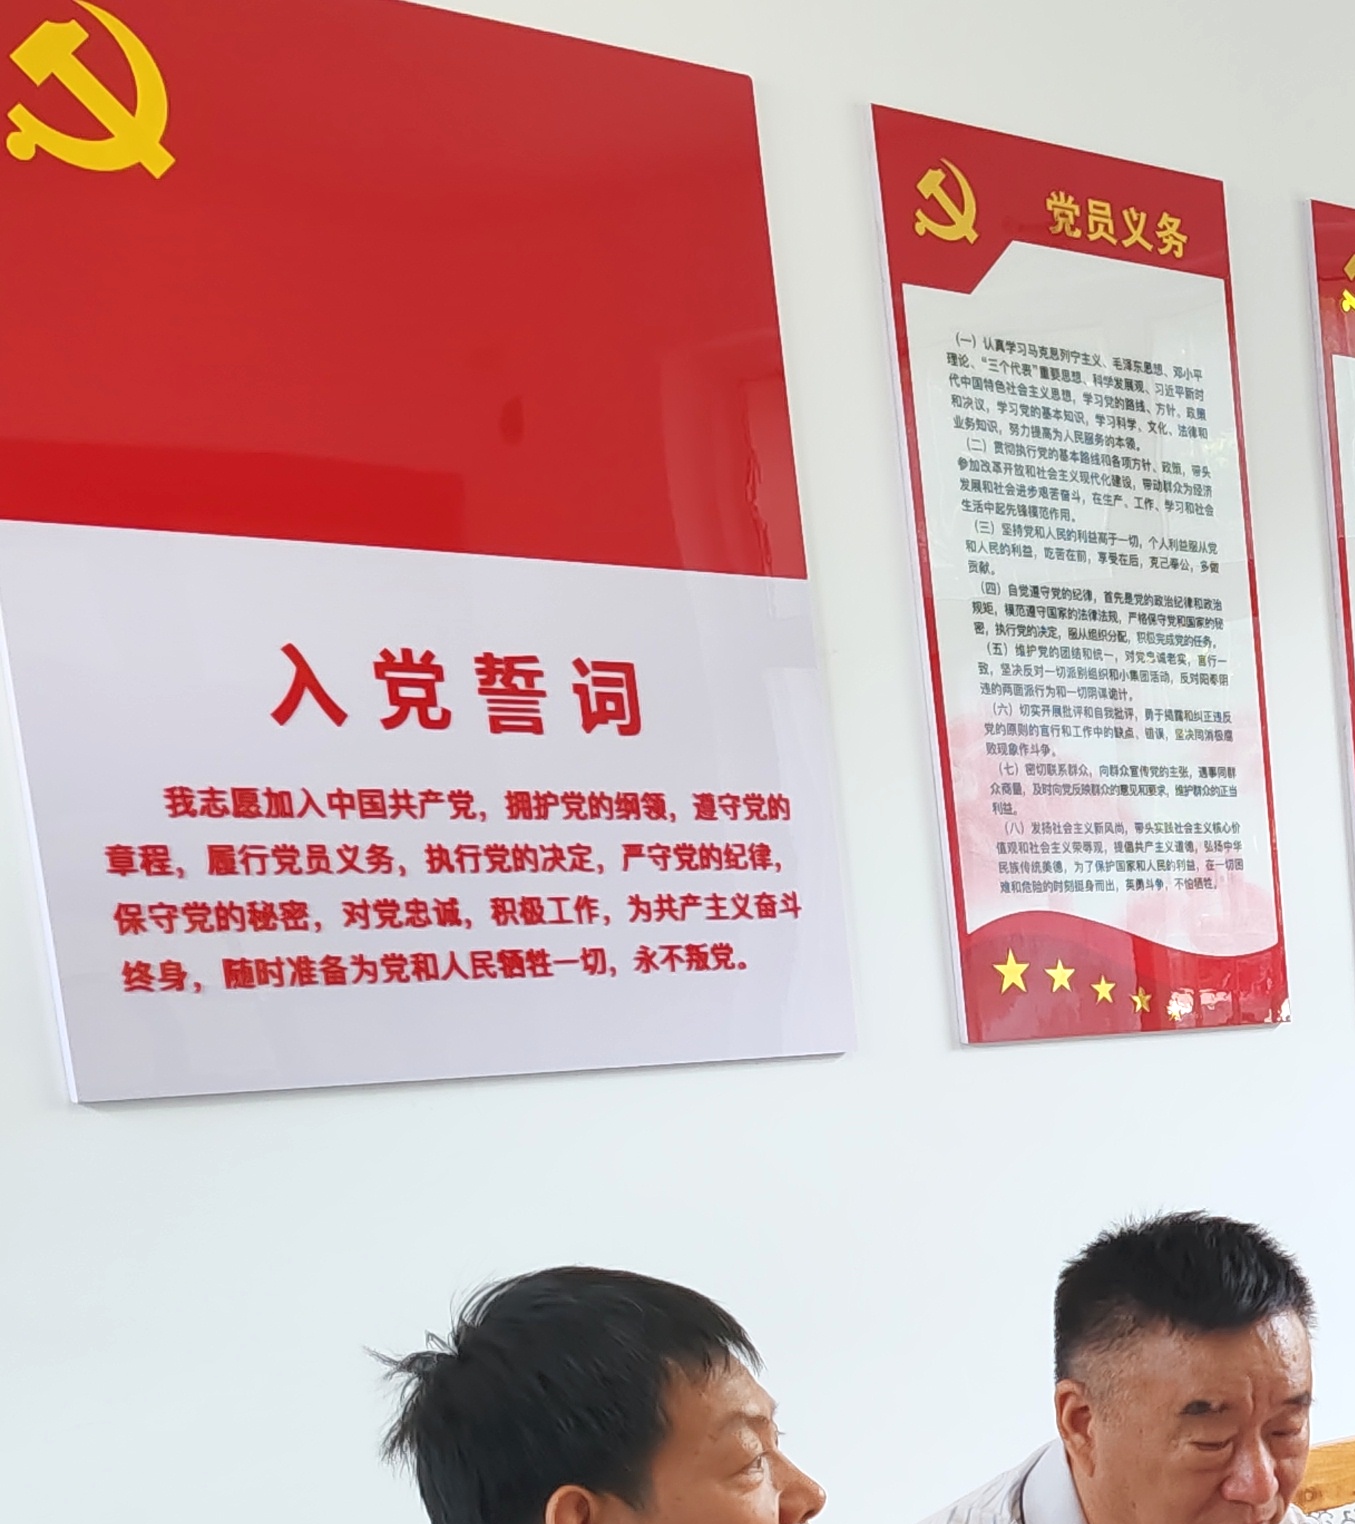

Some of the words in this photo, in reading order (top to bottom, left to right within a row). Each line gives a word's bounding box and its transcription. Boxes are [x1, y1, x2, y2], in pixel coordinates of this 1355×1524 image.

[1045, 190, 1189, 259] 党员义务
[270, 642, 644, 737] 入党誓词
[163, 785, 792, 824] 我志愿加入中国共产党，拥护党的纲领，遵守党的
[104, 842, 784, 879] 章程，履行党员义务，执行党的决定，严守党的纪律，
[114, 893, 803, 935] 保守党的秘密，对党忠诚，积极工作，为共产主义奋斗
[122, 944, 750, 996] 终身，随时准备为党和人民牺牲一切，永不叛党。
